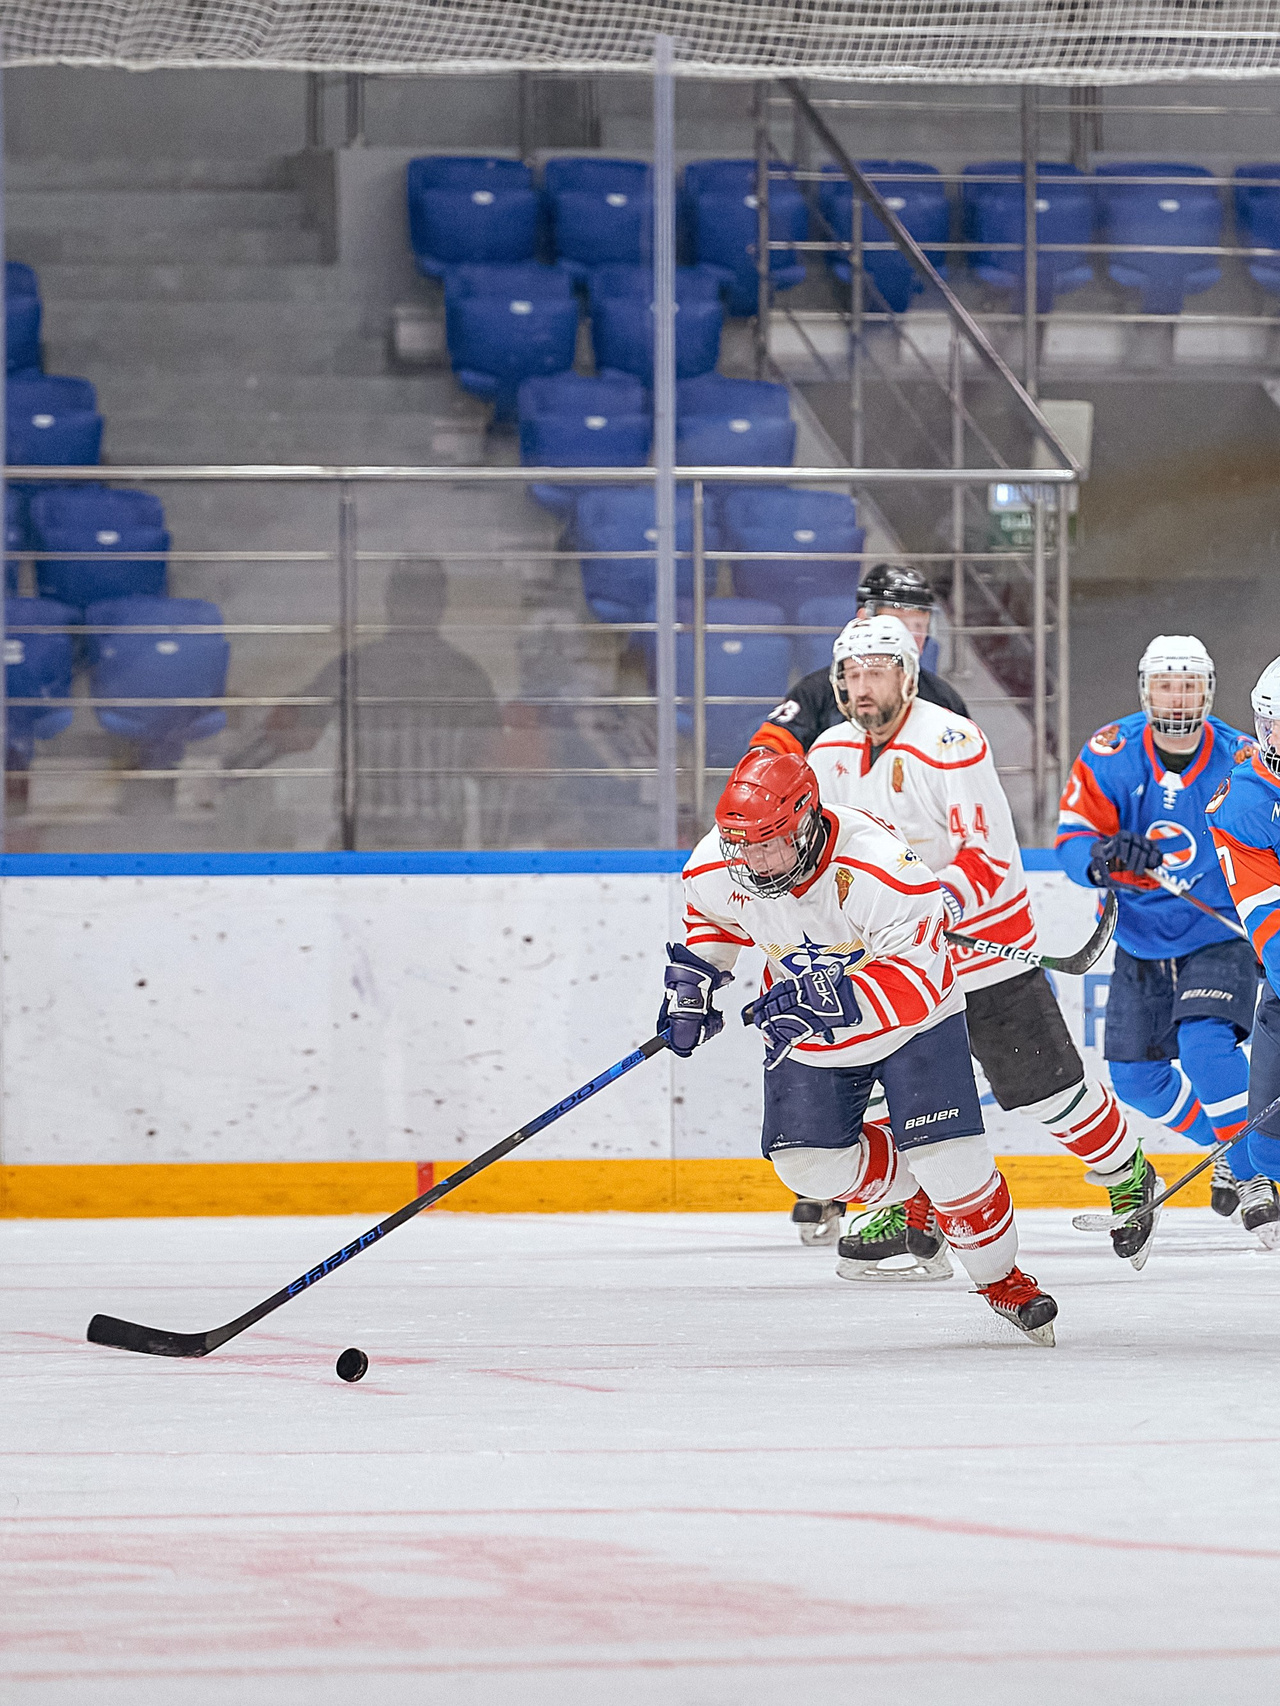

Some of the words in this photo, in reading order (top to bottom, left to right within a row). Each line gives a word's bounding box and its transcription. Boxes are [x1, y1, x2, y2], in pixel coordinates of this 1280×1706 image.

[948, 803, 990, 843] 44
[973, 939, 1043, 967] BAUER
[1180, 988, 1234, 1001] BAUER
[904, 1108, 960, 1130] BAUER
